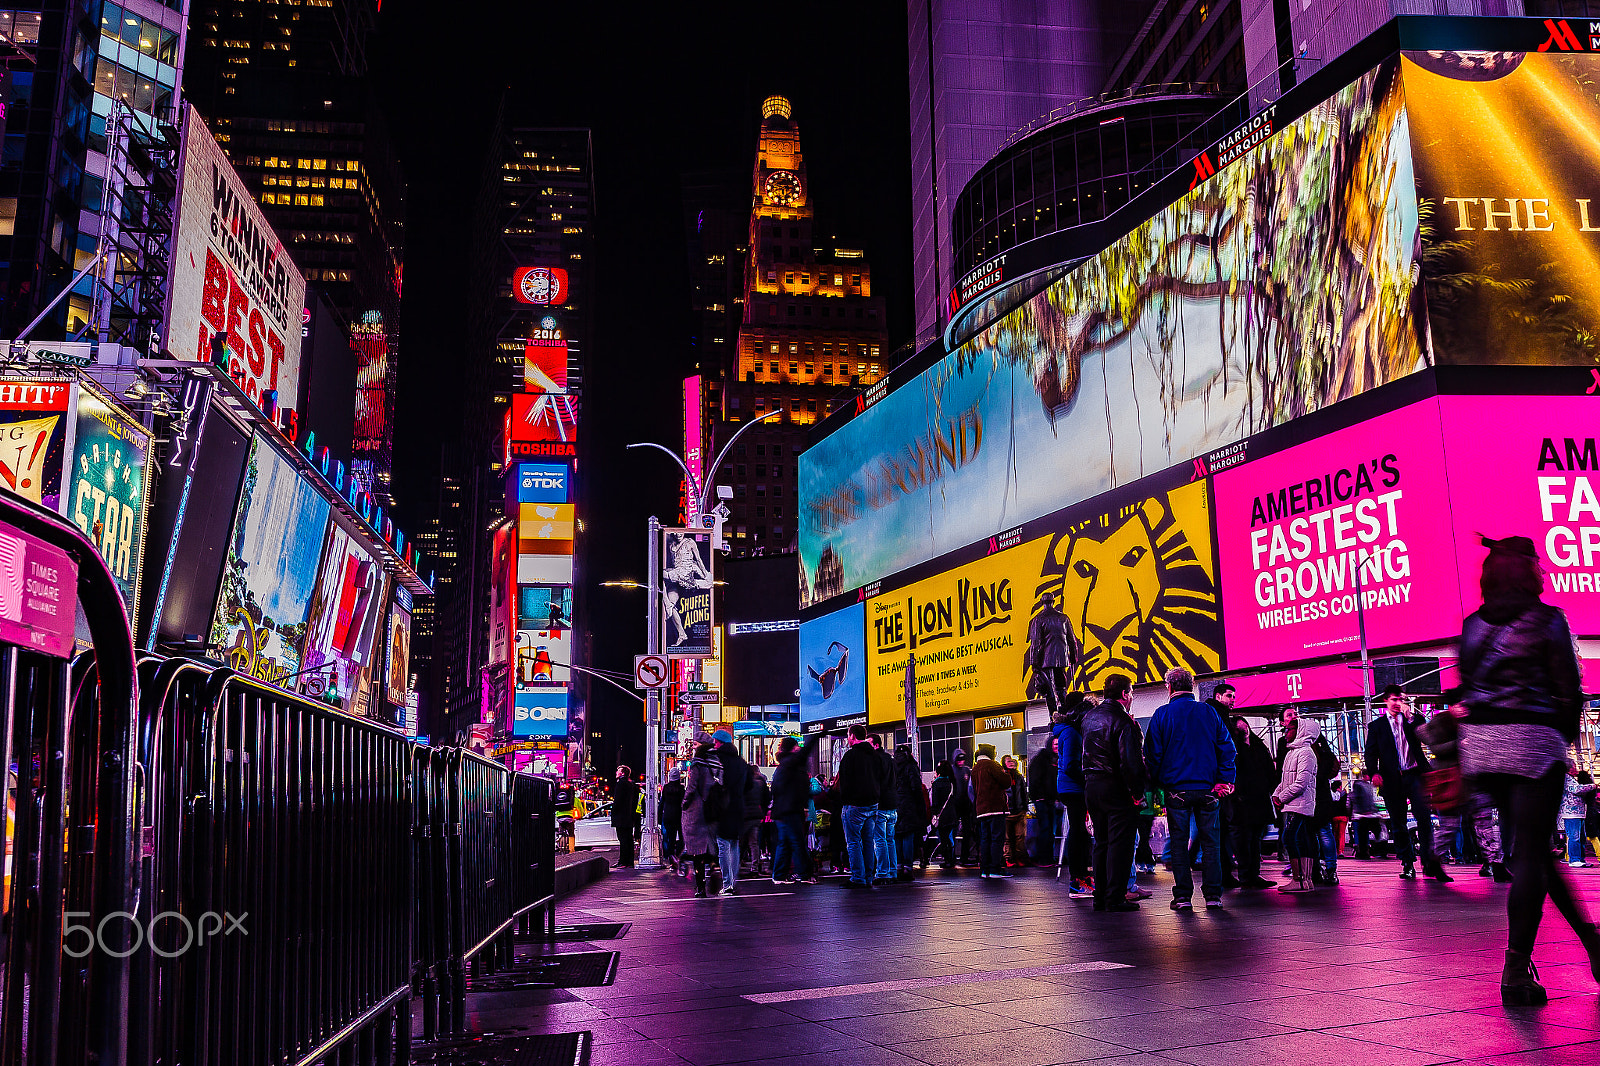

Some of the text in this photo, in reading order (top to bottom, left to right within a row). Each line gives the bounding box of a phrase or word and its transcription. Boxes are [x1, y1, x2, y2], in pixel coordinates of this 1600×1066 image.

[1218, 105, 1276, 153] MARRIOTT
[1219, 124, 1271, 166] MARQUIS
[1443, 197, 1555, 231] THE
[212, 159, 290, 311] WINNER!
[210, 212, 219, 237] 6
[220, 222, 250, 277] TONY
[249, 266, 288, 331] AWARDS
[961, 255, 1006, 289] MARRIOTT
[962, 270, 1000, 302] MARQUIS
[201, 246, 285, 389] BEST
[526, 339, 567, 347] TOSHIBA
[533, 329, 561, 339] 2016
[41, 352, 86, 366] LAMAR
[512, 443, 576, 455] TOSHIBA
[1209, 441, 1249, 462] MARRIOTT
[80, 443, 138, 501] BRIGHT
[1210, 452, 1245, 472] MARQUIS
[531, 478, 564, 489] TDK
[1250, 454, 1400, 527] AMERICA'S
[1538, 477, 1600, 522] FA
[334, 459, 420, 574] BROADWAY
[75, 479, 134, 581] STAR
[999, 528, 1023, 541] MARRIOTT
[1251, 490, 1403, 570] FASTEST
[1000, 536, 1021, 549] MARQUIS
[31, 561, 58, 583] TIMES
[1254, 539, 1411, 608] GROWING
[26, 578, 59, 602] SQUARE
[28, 598, 57, 616] ALLIANCE
[679, 594, 709, 614] SHUFFLE
[874, 577, 1013, 650] THE LION KING
[1257, 582, 1412, 629] WIRELESS COMPANY
[684, 607, 710, 629] ALONG
[30, 632, 46, 646] NYC
[877, 664, 890, 676] THE
[956, 644, 974, 659] BEST
[975, 634, 1014, 655] MUSICAL
[956, 667, 961, 677] A
[961, 664, 978, 675] WEEK
[683, 693, 717, 701] ONE WAY
[689, 683, 695, 691] W
[1288, 674, 1303, 699] T
[983, 716, 1014, 729] INVICTA
